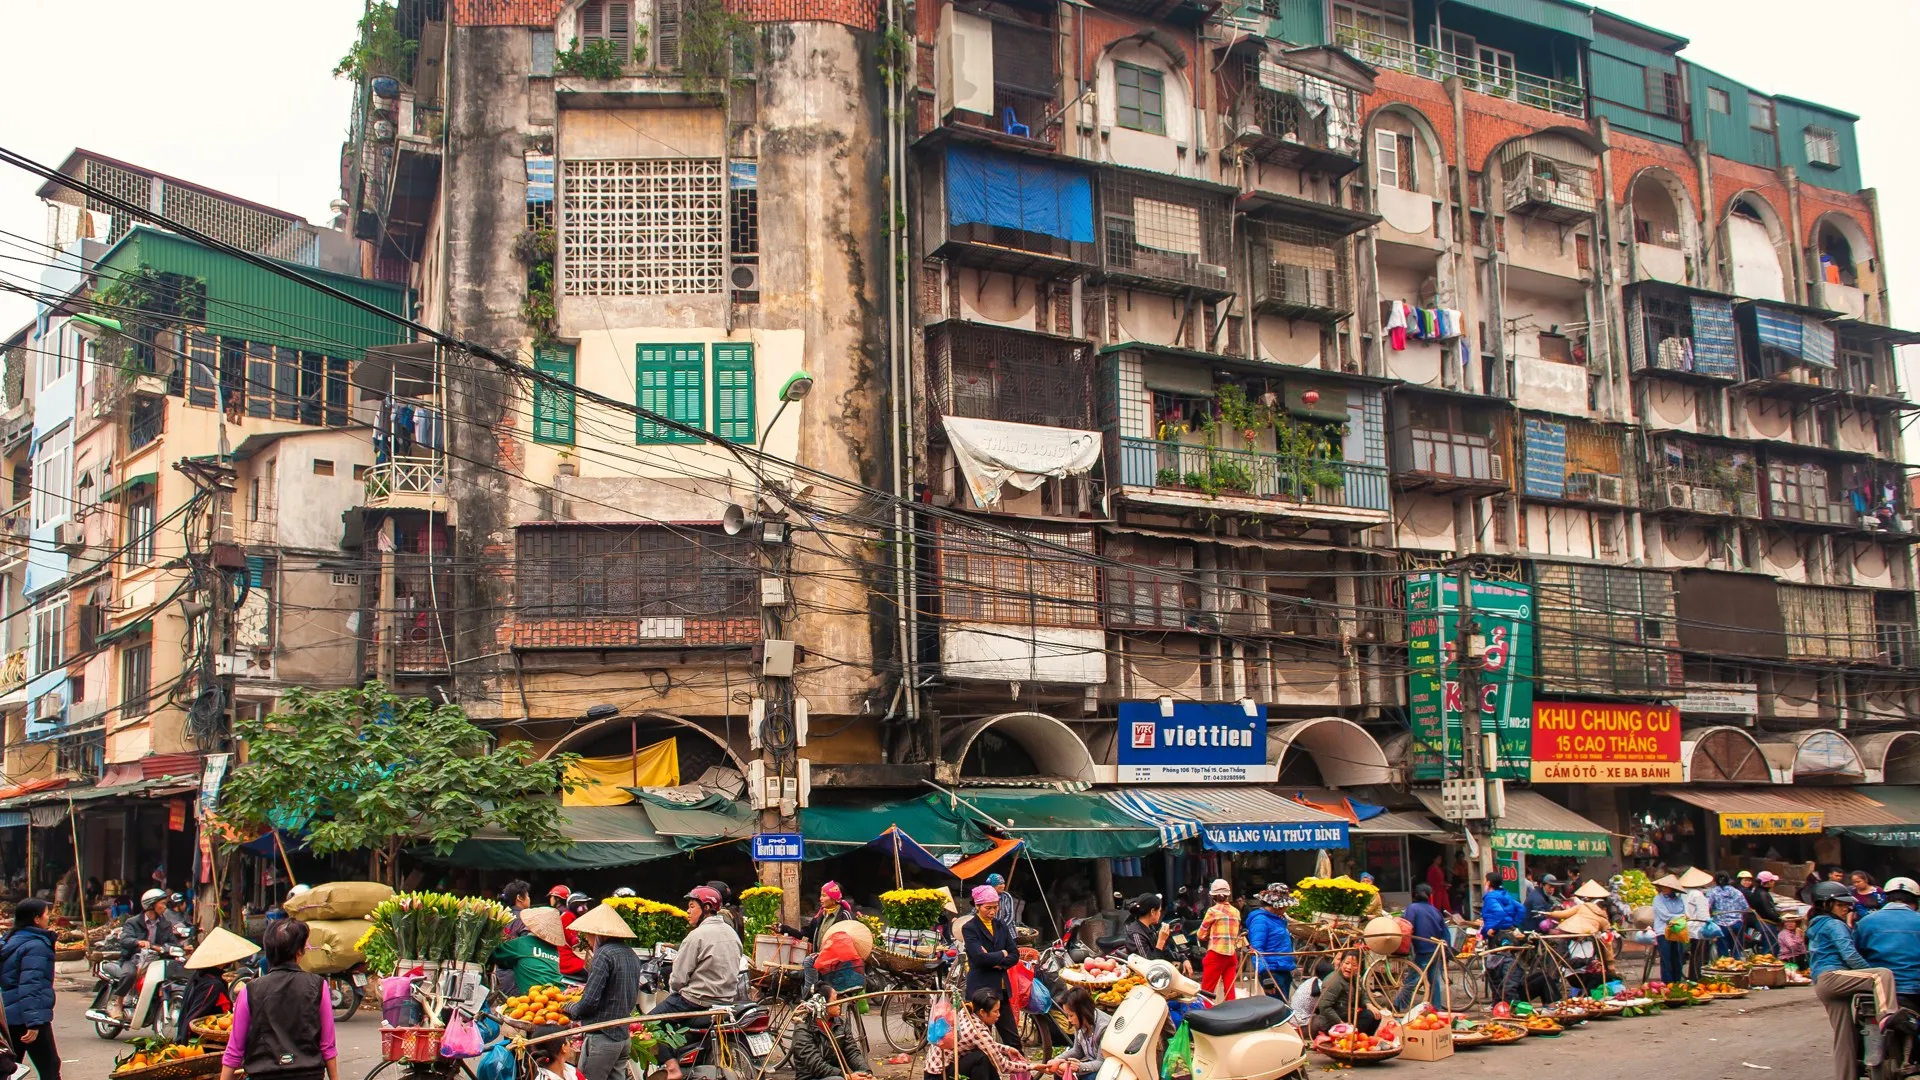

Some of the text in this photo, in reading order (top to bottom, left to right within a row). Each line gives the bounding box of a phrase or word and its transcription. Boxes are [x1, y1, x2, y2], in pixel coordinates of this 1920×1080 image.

[1445, 681, 1498, 713] KC
[1538, 708, 1671, 732] KHU CHUNG CƯ
[1163, 725, 1252, 747] viettien
[1556, 730, 1658, 752] 15 CAO THẮNG
[1545, 762, 1570, 778] CẤM
[1572, 765, 1581, 778] Ô
[1582, 765, 1597, 778] TÔ
[1607, 767, 1621, 778] XE
[1624, 767, 1638, 778] BA
[1228, 826, 1260, 843] HÀNG
[1314, 824, 1341, 841] BÌNH
[1505, 832, 1535, 849] KCC
[1502, 864, 1518, 881] BÒ
